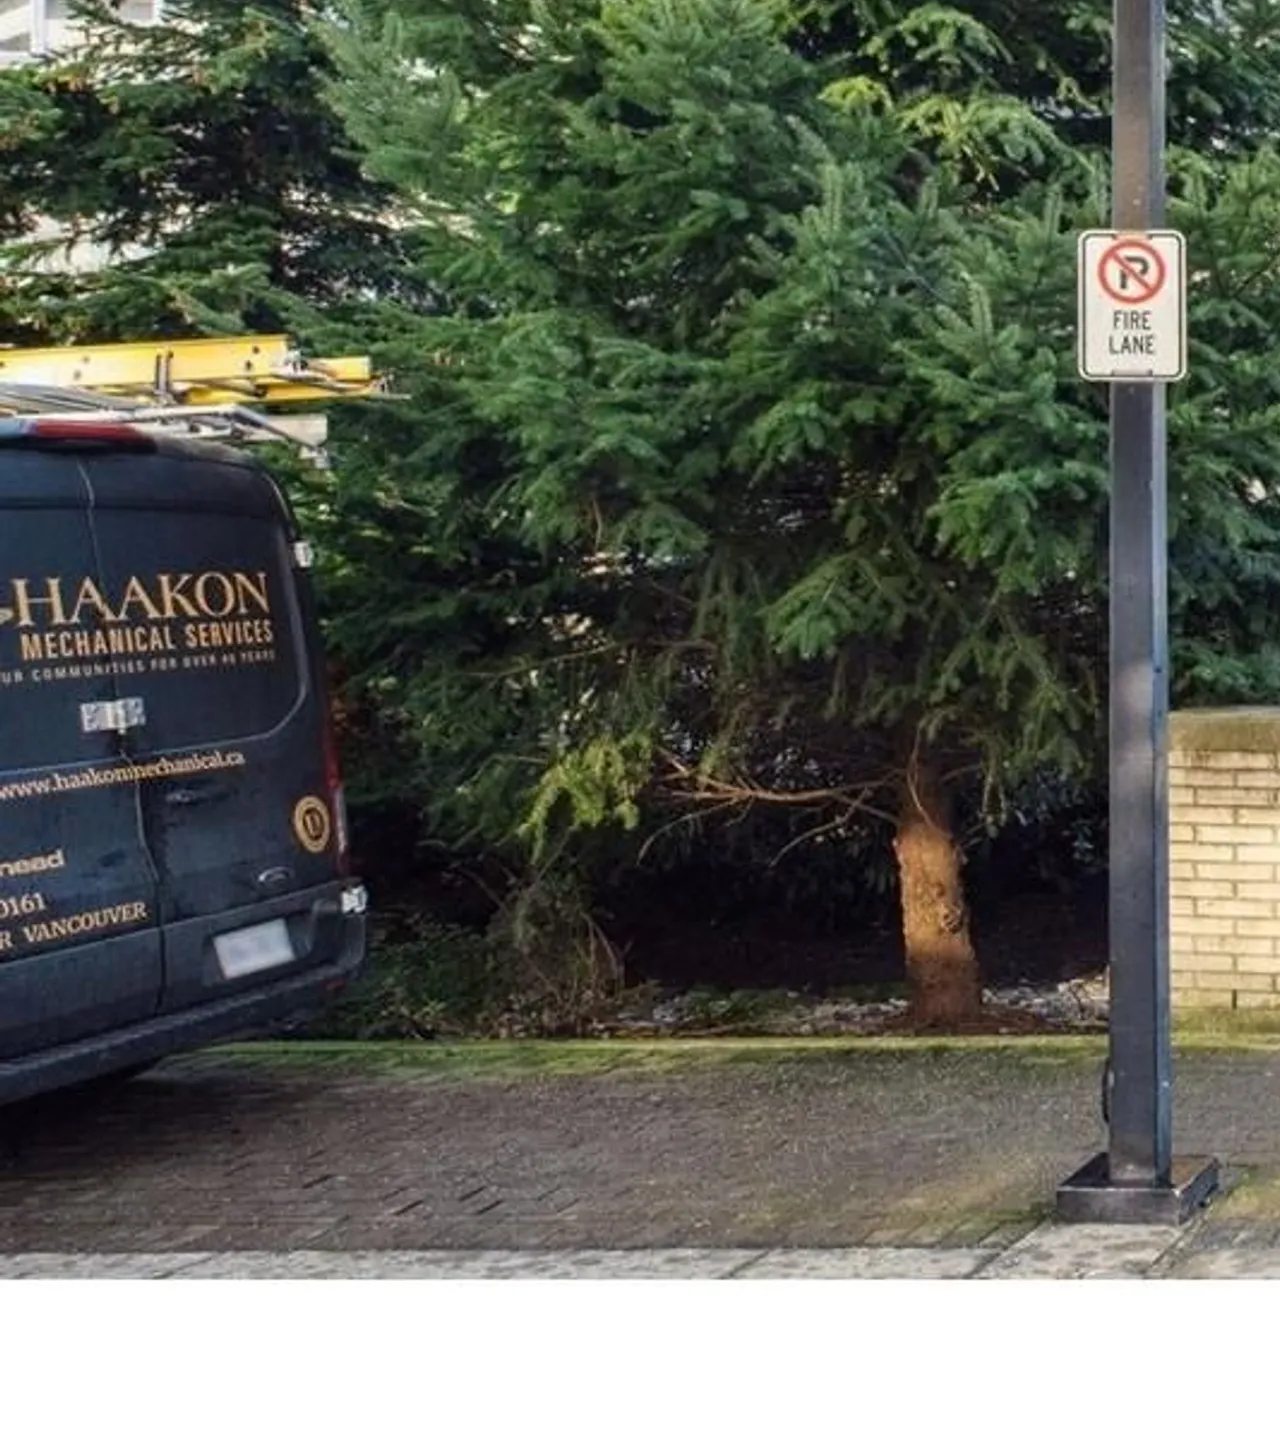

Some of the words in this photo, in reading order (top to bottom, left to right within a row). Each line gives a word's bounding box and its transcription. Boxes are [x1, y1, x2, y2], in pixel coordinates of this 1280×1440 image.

[1113, 310, 1152, 331] FIRE
[1109, 336, 1155, 355] LANE
[12, 571, 271, 628] HAAKON
[20, 625, 177, 661] MECHANICAL
[185, 618, 274, 649] SERVICES
[23, 901, 148, 943] VANCOUVER
